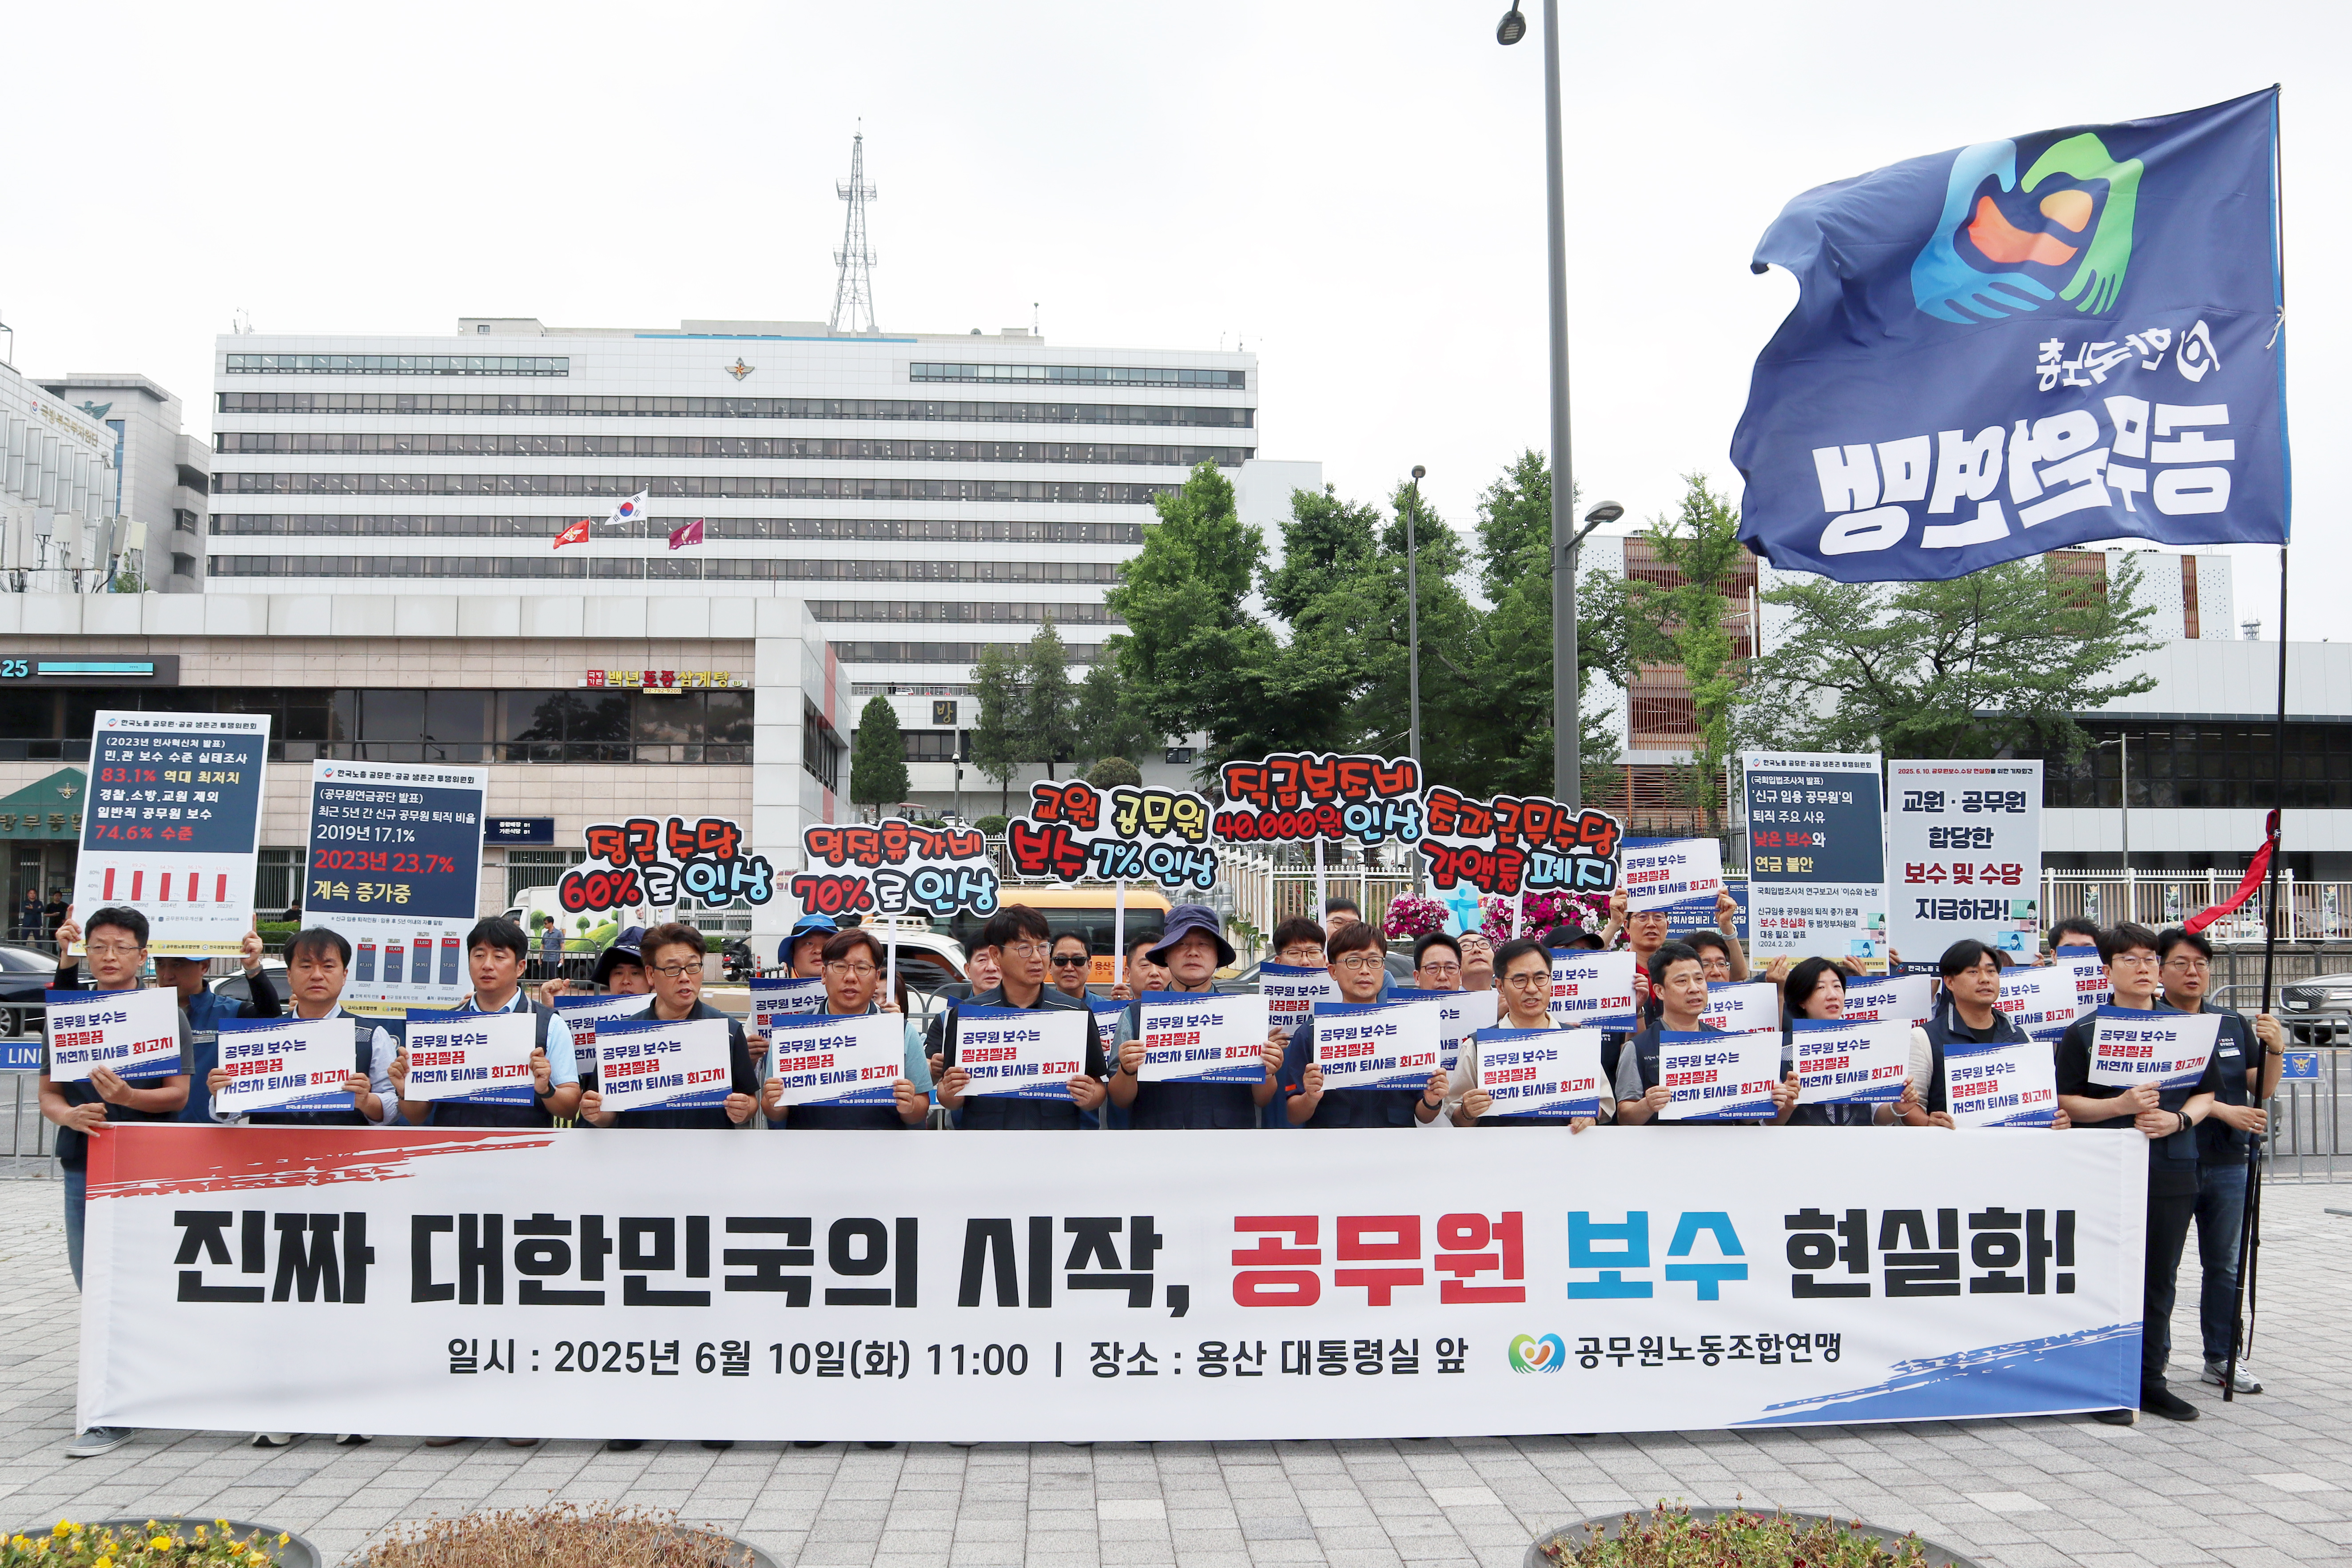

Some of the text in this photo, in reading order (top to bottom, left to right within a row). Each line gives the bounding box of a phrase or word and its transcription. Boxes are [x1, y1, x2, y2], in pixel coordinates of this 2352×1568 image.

[0, 660, 28, 677] 25
[936, 702, 954, 723] 방
[107, 738, 149, 746] (2023년
[153, 739, 199, 747] 인사혁신처
[105, 750, 247, 764] 민.관 보수 수준 실태조사
[101, 768, 239, 784] 83.1% 역대 최저치
[1228, 760, 1413, 806] 직급보조비
[1751, 776, 1823, 786] (국회입법조사처 발표)
[100, 789, 219, 803] 경찰.소방.교원 제외
[320, 789, 423, 804] (공무원연금공단 발표)
[1781, 791, 1803, 803] 임용
[1903, 791, 2026, 812] 교원 공무원
[98, 807, 211, 820] 일반직 공무원 보수
[318, 806, 475, 824] 최근 5년 간 신규 공무원 퇴직 비율
[1036, 787, 1204, 839] 교원 공무원
[1216, 804, 1418, 840] 40,000원 인상
[1753, 810, 1825, 824] 퇴직 주요 사유
[96, 825, 193, 840] 74.6% 수준
[317, 824, 414, 842] 2019년 17.1%
[1429, 794, 1616, 855] 초과근무수당
[589, 823, 736, 864] 정근 수당
[808, 823, 981, 864] 명절휴가비
[1754, 832, 1826, 848] 낮은 보수와
[1929, 827, 1994, 848] 합당한
[314, 849, 454, 873] 2023년 23.7%
[1015, 826, 1214, 885] 보수 7% 인상
[1755, 856, 1813, 872] 연금 불안
[1530, 852, 1611, 886] 폐지
[1905, 863, 2023, 885] 보수 및 수당
[686, 862, 768, 902] 인상
[915, 872, 993, 909] 인상
[313, 881, 411, 903] 계속 증가중
[1916, 899, 2009, 921] 지급하라!
[1780, 918, 1806, 928] 현실화
[54, 1011, 126, 1029] 공무원 보수는
[1147, 1014, 1223, 1030] 공무원 보수는
[2101, 1030, 2177, 1041] 공무원 보수는
[8, 1048, 41, 1064] LIN
[56, 1037, 172, 1064] 저연차 퇴사율 최고치
[1145, 1045, 1263, 1064] 저연차 퇴사율 최고치
[2096, 1057, 2205, 1072] 저연차 퇴사율 최고치
[174, 1207, 2075, 1317] 진짜 대한민국의 시작, 공무원 보수 현실화!
[449, 1338, 1468, 1379] 일시 2025년 6월 10일(화) 11:00 장소 용산 대통령실 앞
[1575, 1333, 1841, 1369] 공무원노동조합연맹
